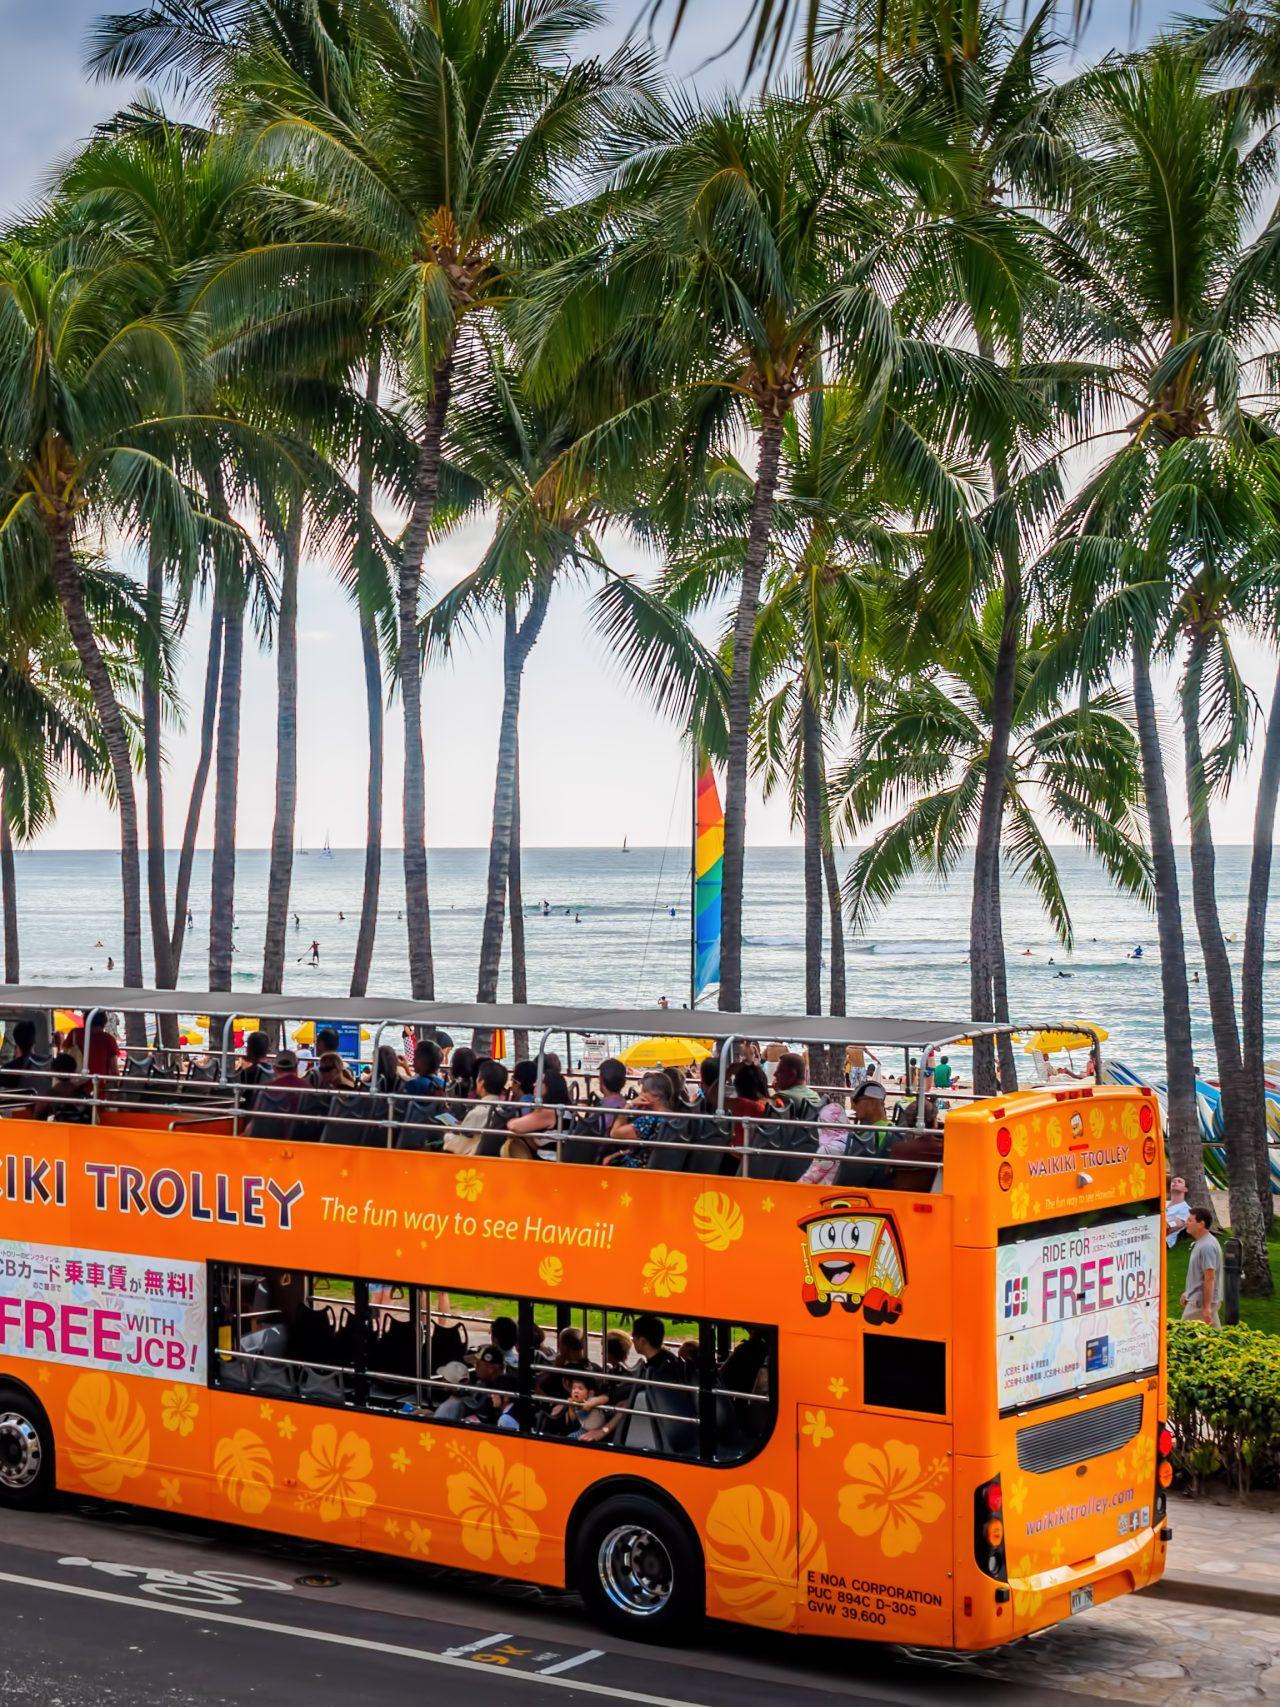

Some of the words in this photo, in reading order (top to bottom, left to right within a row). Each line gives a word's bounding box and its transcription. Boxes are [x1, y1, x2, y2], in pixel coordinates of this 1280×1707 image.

[1027, 1154, 1077, 1178] WAIKIKI
[1081, 1146, 1130, 1170] TROLLEY
[84, 1161, 305, 1230] TROLLEY
[320, 1196, 358, 1224] The
[363, 1199, 398, 1228] fun
[403, 1209, 449, 1240] way
[453, 1212, 477, 1236] to
[482, 1218, 519, 1240] see
[523, 1215, 615, 1249] Hawaii!
[1042, 1242, 1066, 1264] RIDE
[1070, 1237, 1090, 1257] FOR
[1116, 1250, 1141, 1272] WITH
[1042, 1257, 1114, 1322] FREE
[1116, 1268, 1152, 1304] JCB!
[126, 1313, 175, 1336] WITH
[126, 1336, 198, 1372] JCB!
[807, 1571, 815, 1583] E
[820, 1574, 846, 1588] NOA
[851, 1579, 942, 1606] CORPORATION
[807, 1586, 832, 1600] PUC
[837, 1591, 871, 1608] 894C
[876, 1598, 917, 1616] D-305
[808, 1600, 836, 1615] GVW
